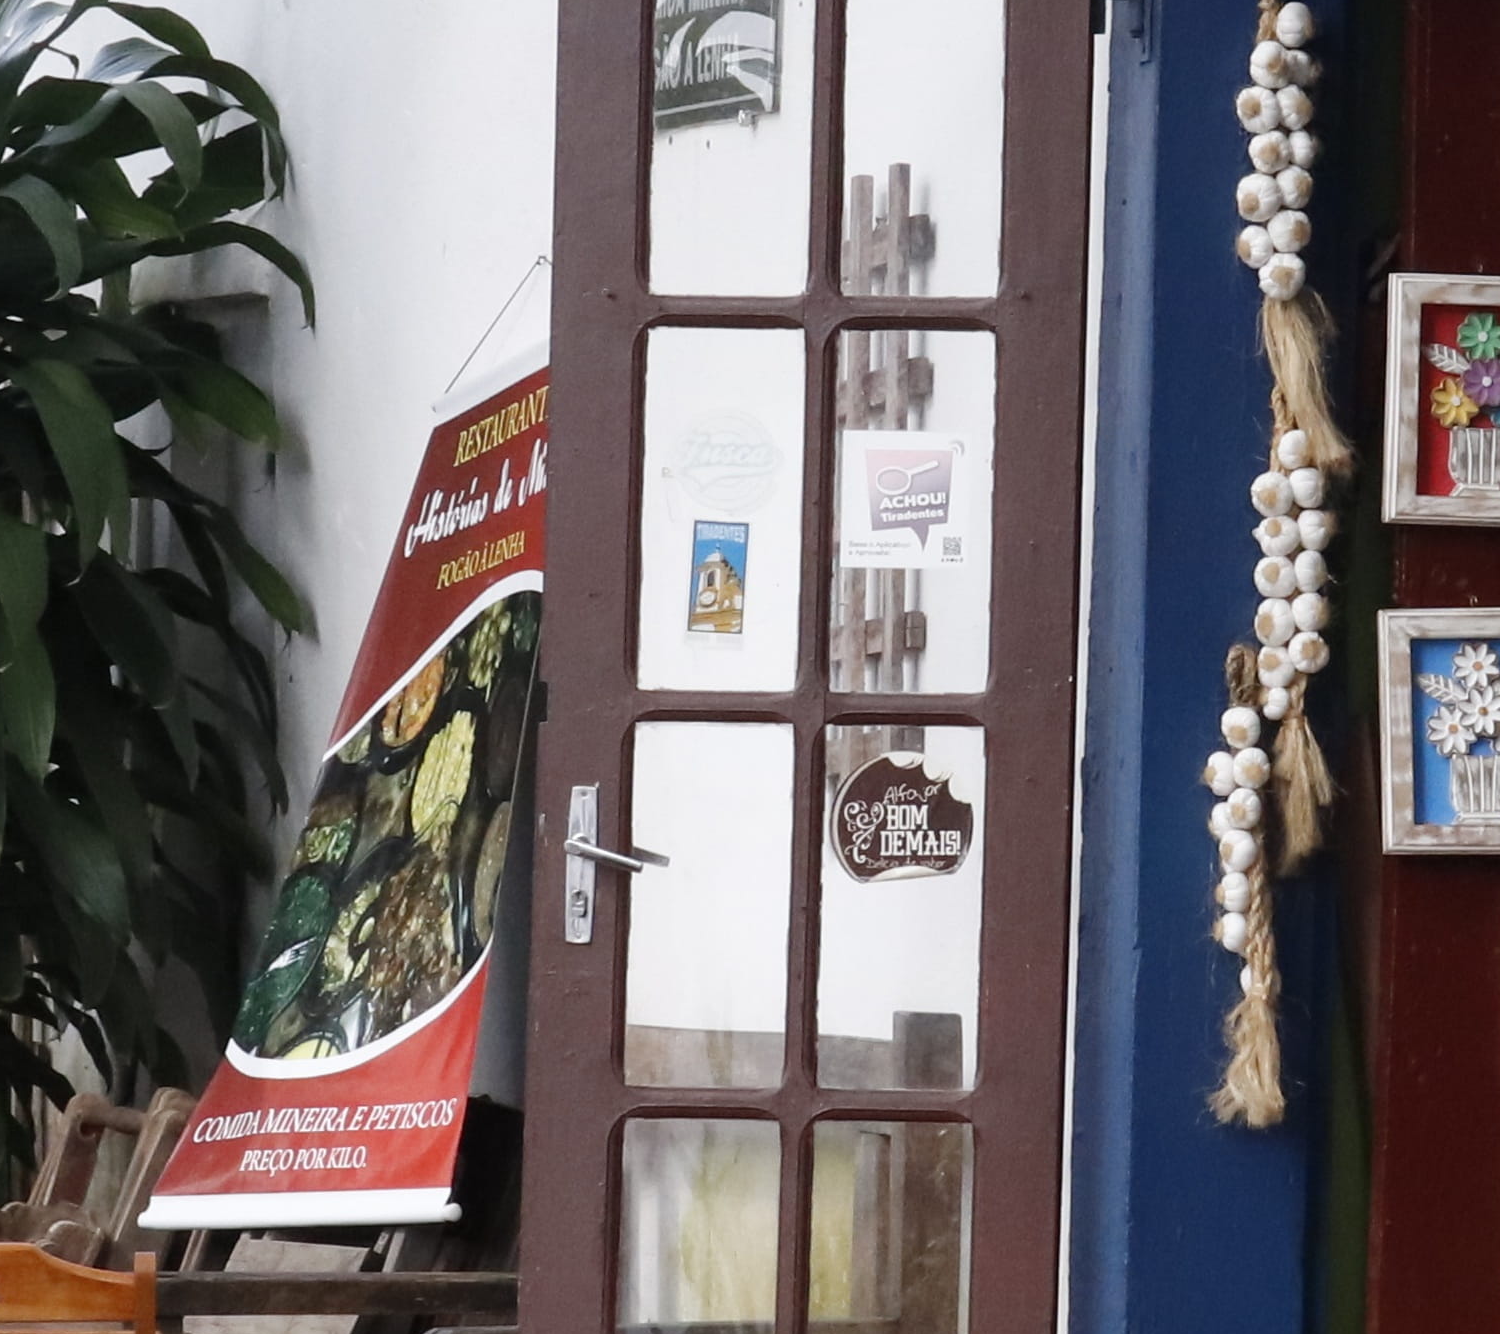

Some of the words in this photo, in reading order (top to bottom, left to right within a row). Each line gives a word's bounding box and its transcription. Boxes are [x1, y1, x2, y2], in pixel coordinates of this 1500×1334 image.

[453, 385, 549, 468] RESTAURANT
[493, 458, 514, 514] de
[879, 492, 947, 510] ACHOU!
[880, 508, 945, 522] Tiradentes
[436, 549, 479, 591] FOGÃO
[488, 530, 526, 568] LENHA
[886, 804, 929, 831] BOM
[880, 830, 962, 857] DEMAIS!
[192, 1109, 260, 1143] COMIDA
[261, 1106, 350, 1135] MINEIRA
[349, 1105, 366, 1132] E
[364, 1097, 458, 1131] PETISCOS
[238, 1148, 293, 1178] PREÇO
[293, 1147, 330, 1171] POR
[327, 1146, 368, 1169] KILO.
